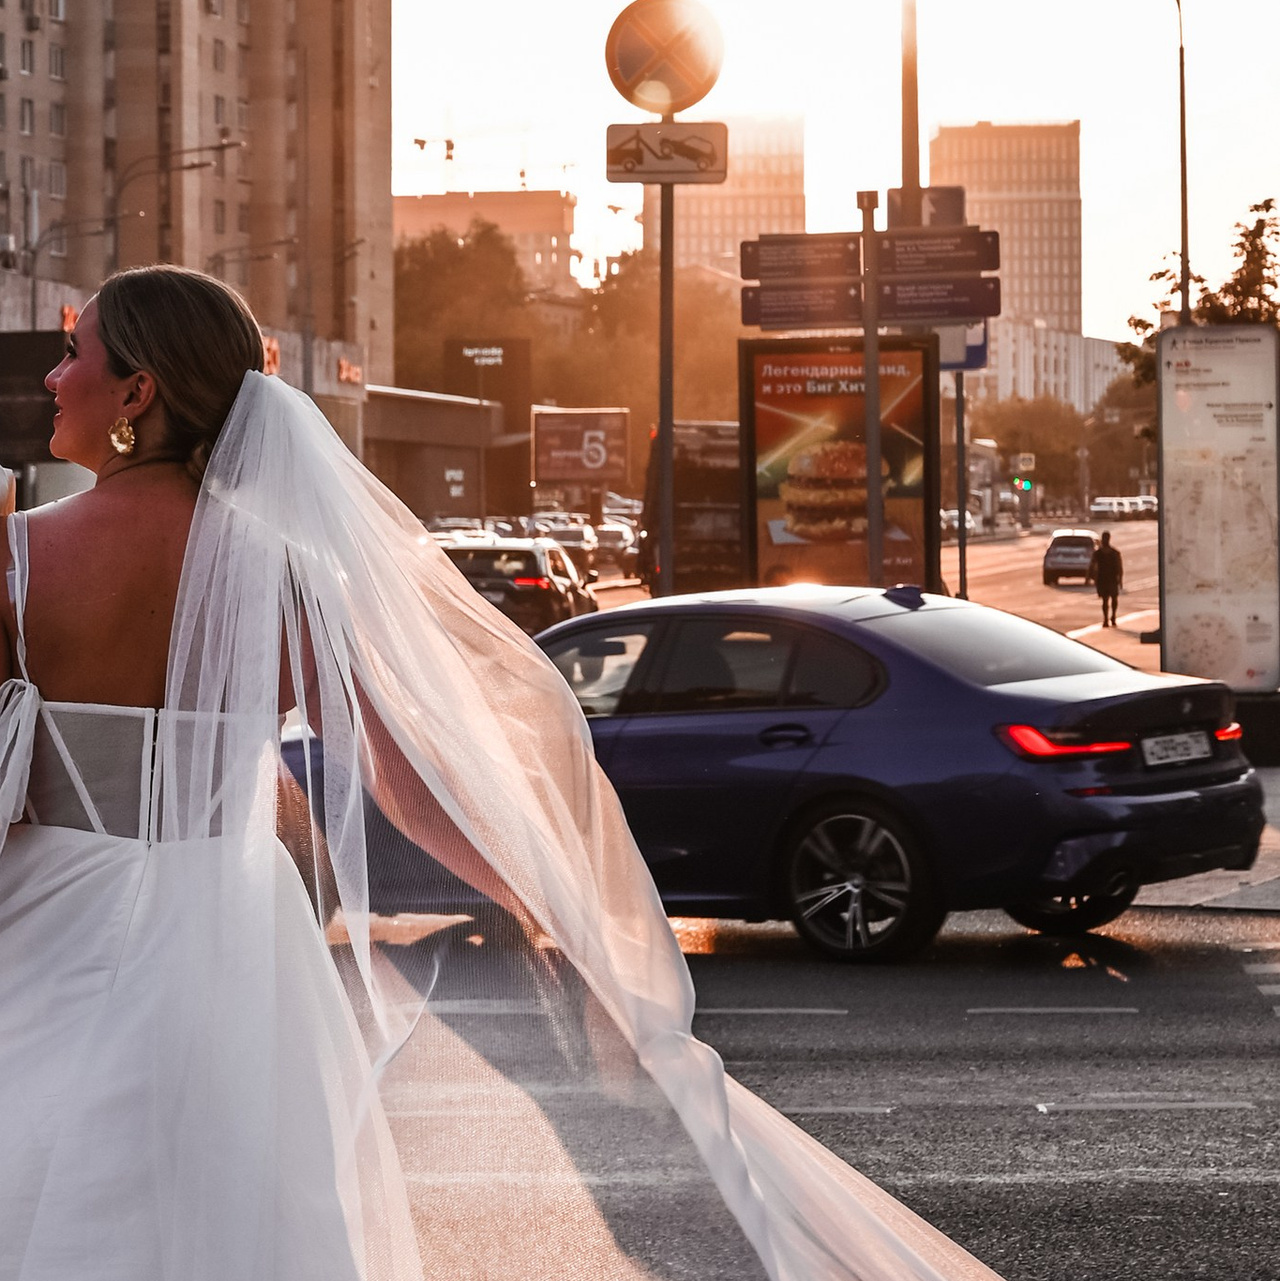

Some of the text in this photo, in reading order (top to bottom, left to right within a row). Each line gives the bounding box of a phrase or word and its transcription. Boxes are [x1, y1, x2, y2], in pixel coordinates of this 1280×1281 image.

[762, 363, 865, 379] Легендарны
[776, 383, 802, 395] это
[806, 380, 834, 394] Биг
